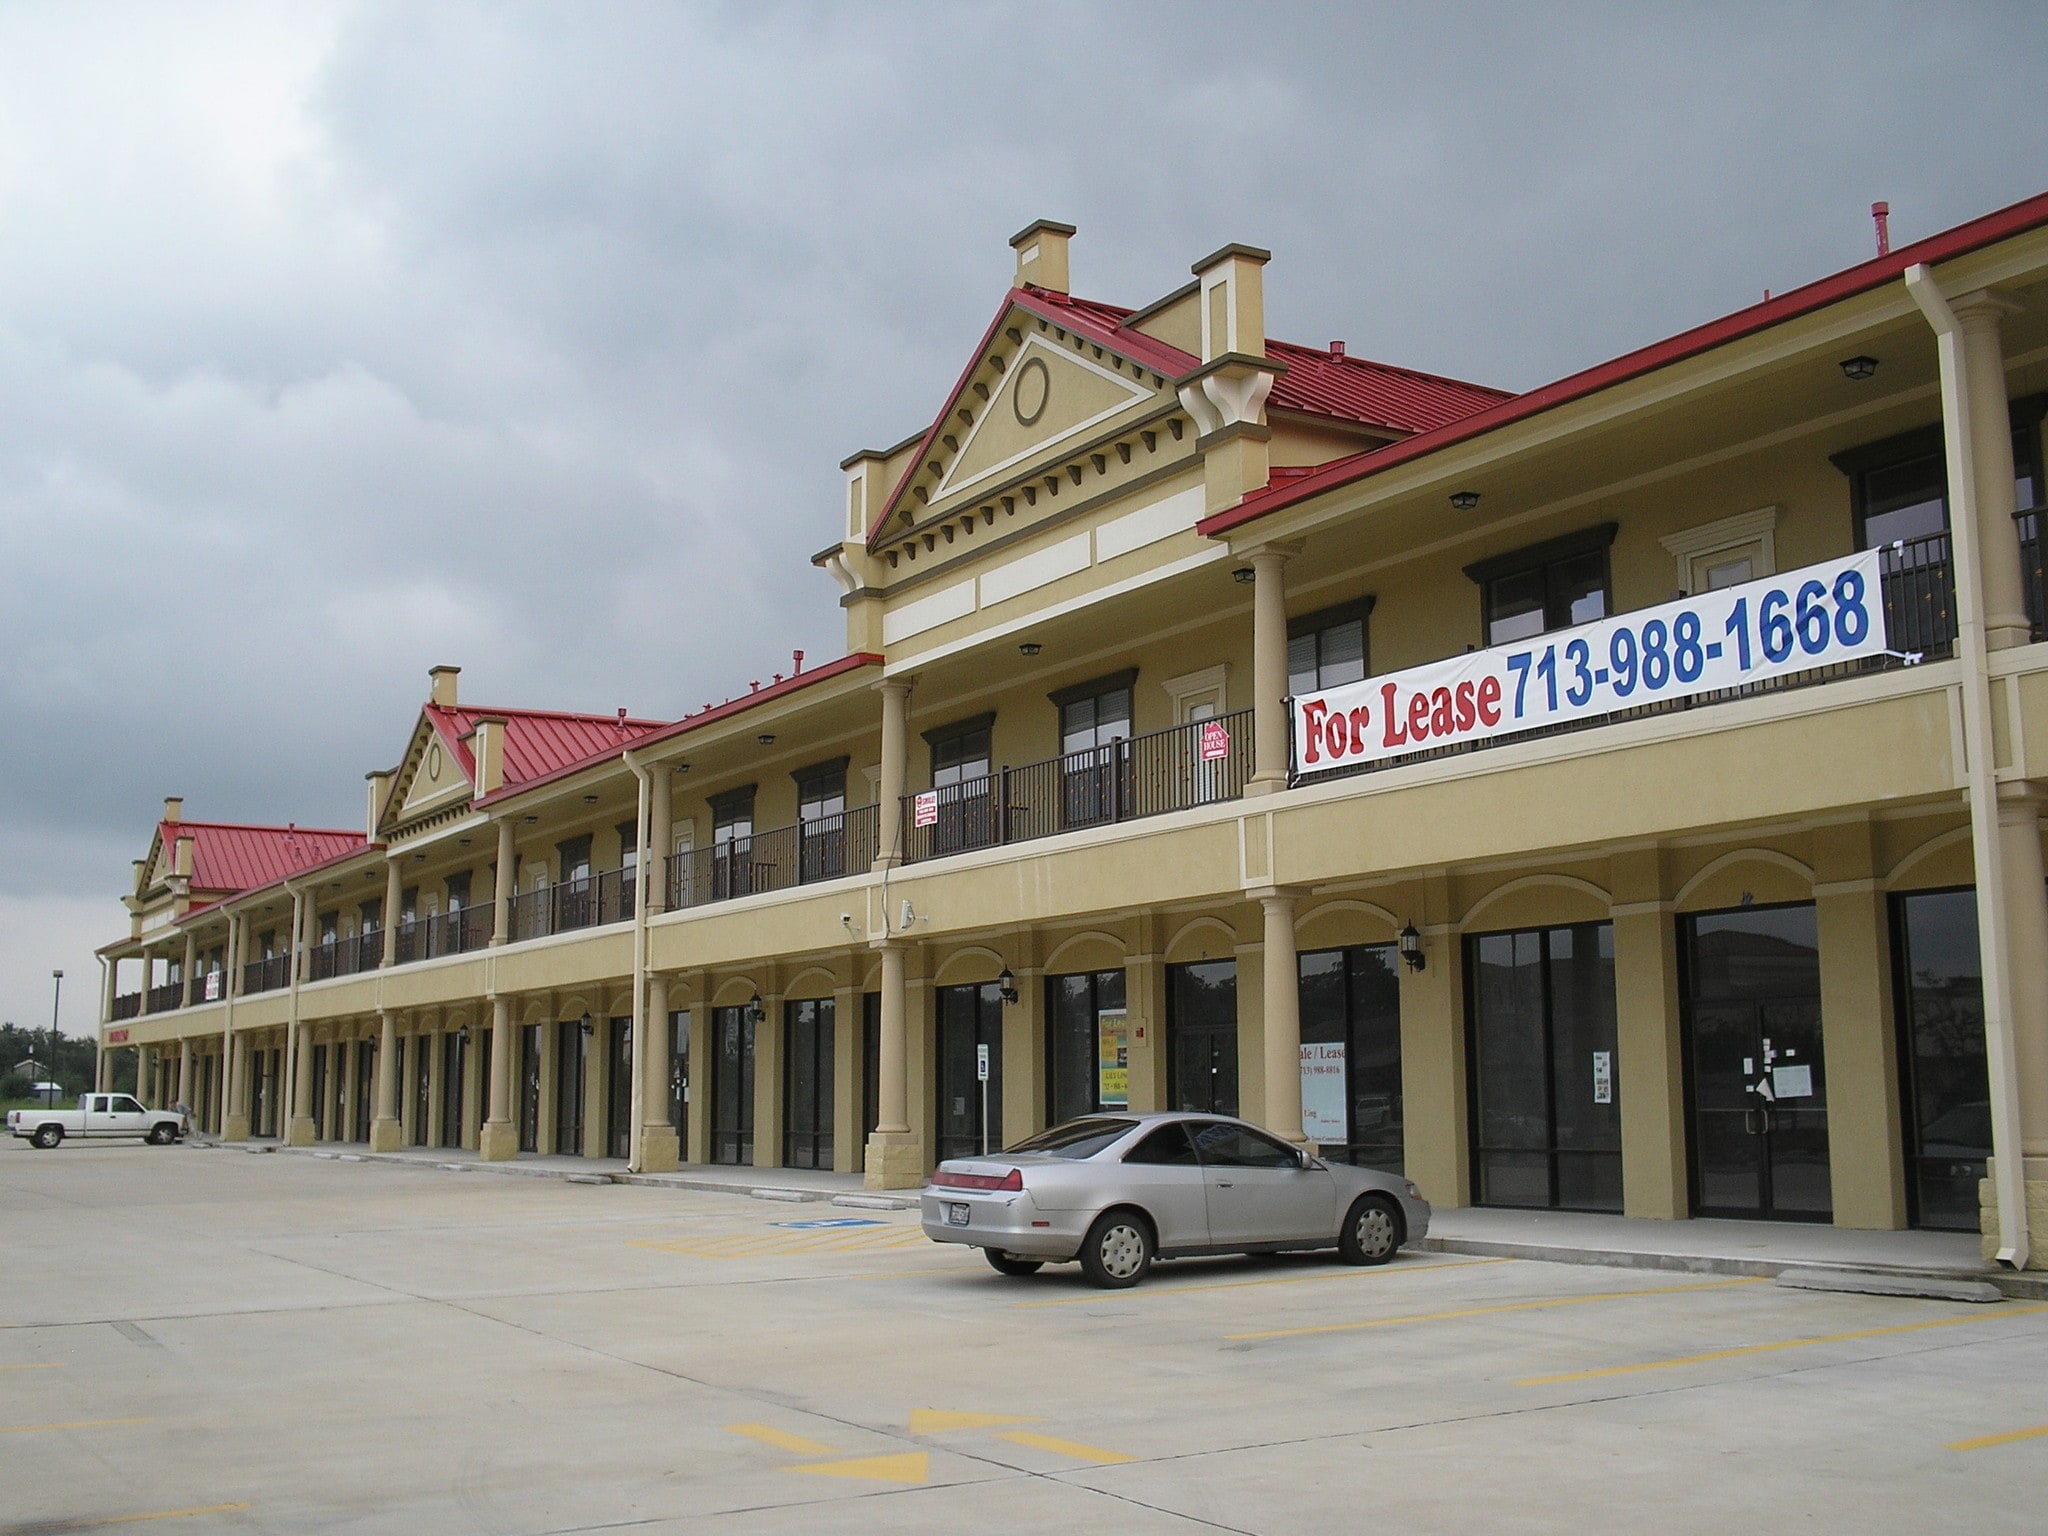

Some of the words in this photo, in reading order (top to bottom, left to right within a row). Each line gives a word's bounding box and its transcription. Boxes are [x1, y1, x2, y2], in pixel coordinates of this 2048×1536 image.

[1302, 697, 1371, 764] For
[1381, 674, 1502, 748] Lease
[1506, 568, 1870, 719] 713-988-1668
[1204, 730, 1223, 741] OPEN
[1203, 738, 1226, 751] HOUSE
